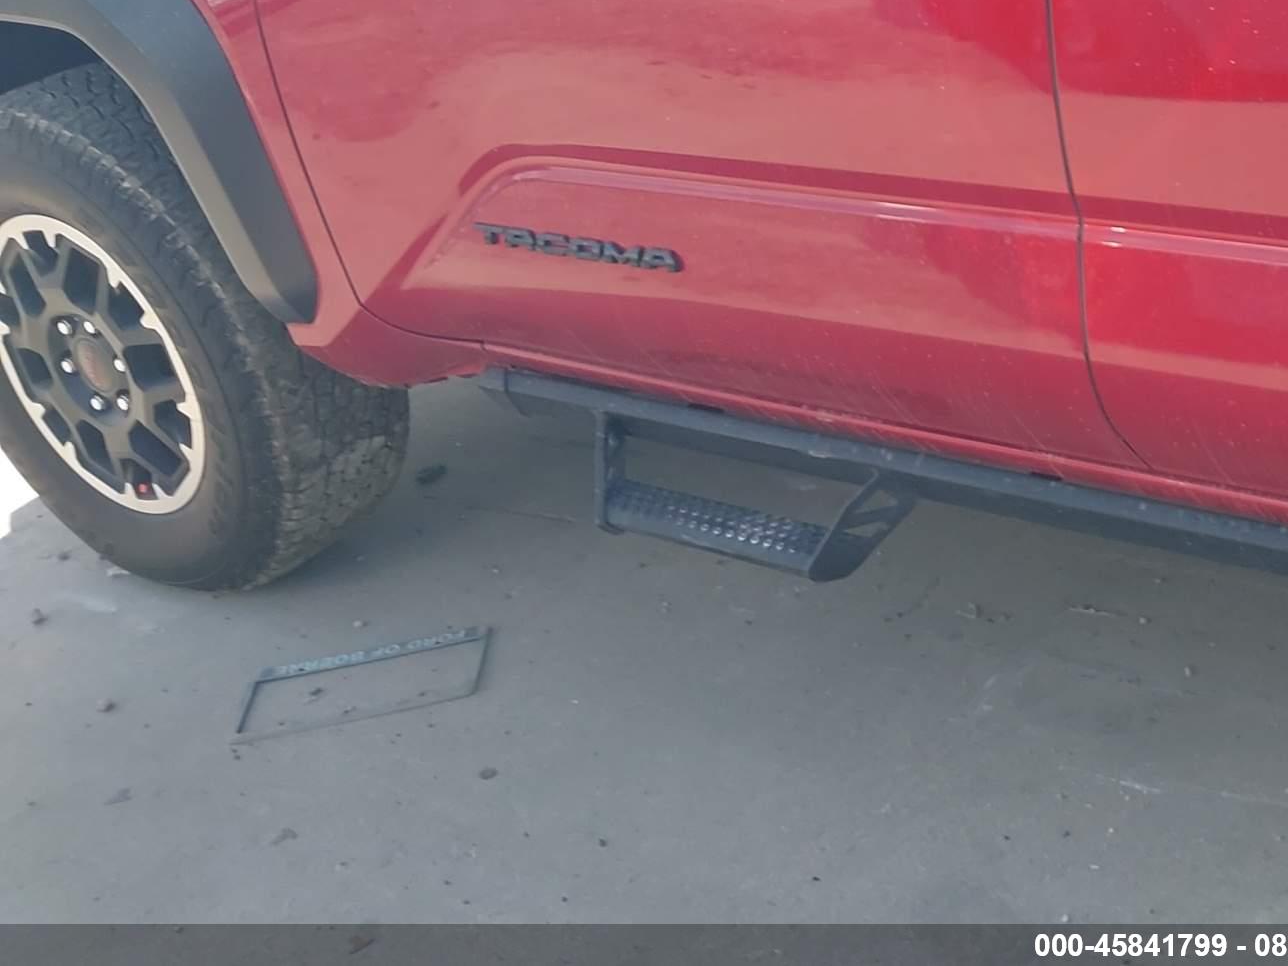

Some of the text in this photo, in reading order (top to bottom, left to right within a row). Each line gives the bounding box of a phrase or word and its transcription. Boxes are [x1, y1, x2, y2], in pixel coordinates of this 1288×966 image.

[473, 222, 684, 273] TACOMA
[371, 644, 401, 658] OF
[406, 630, 466, 651] FORD
